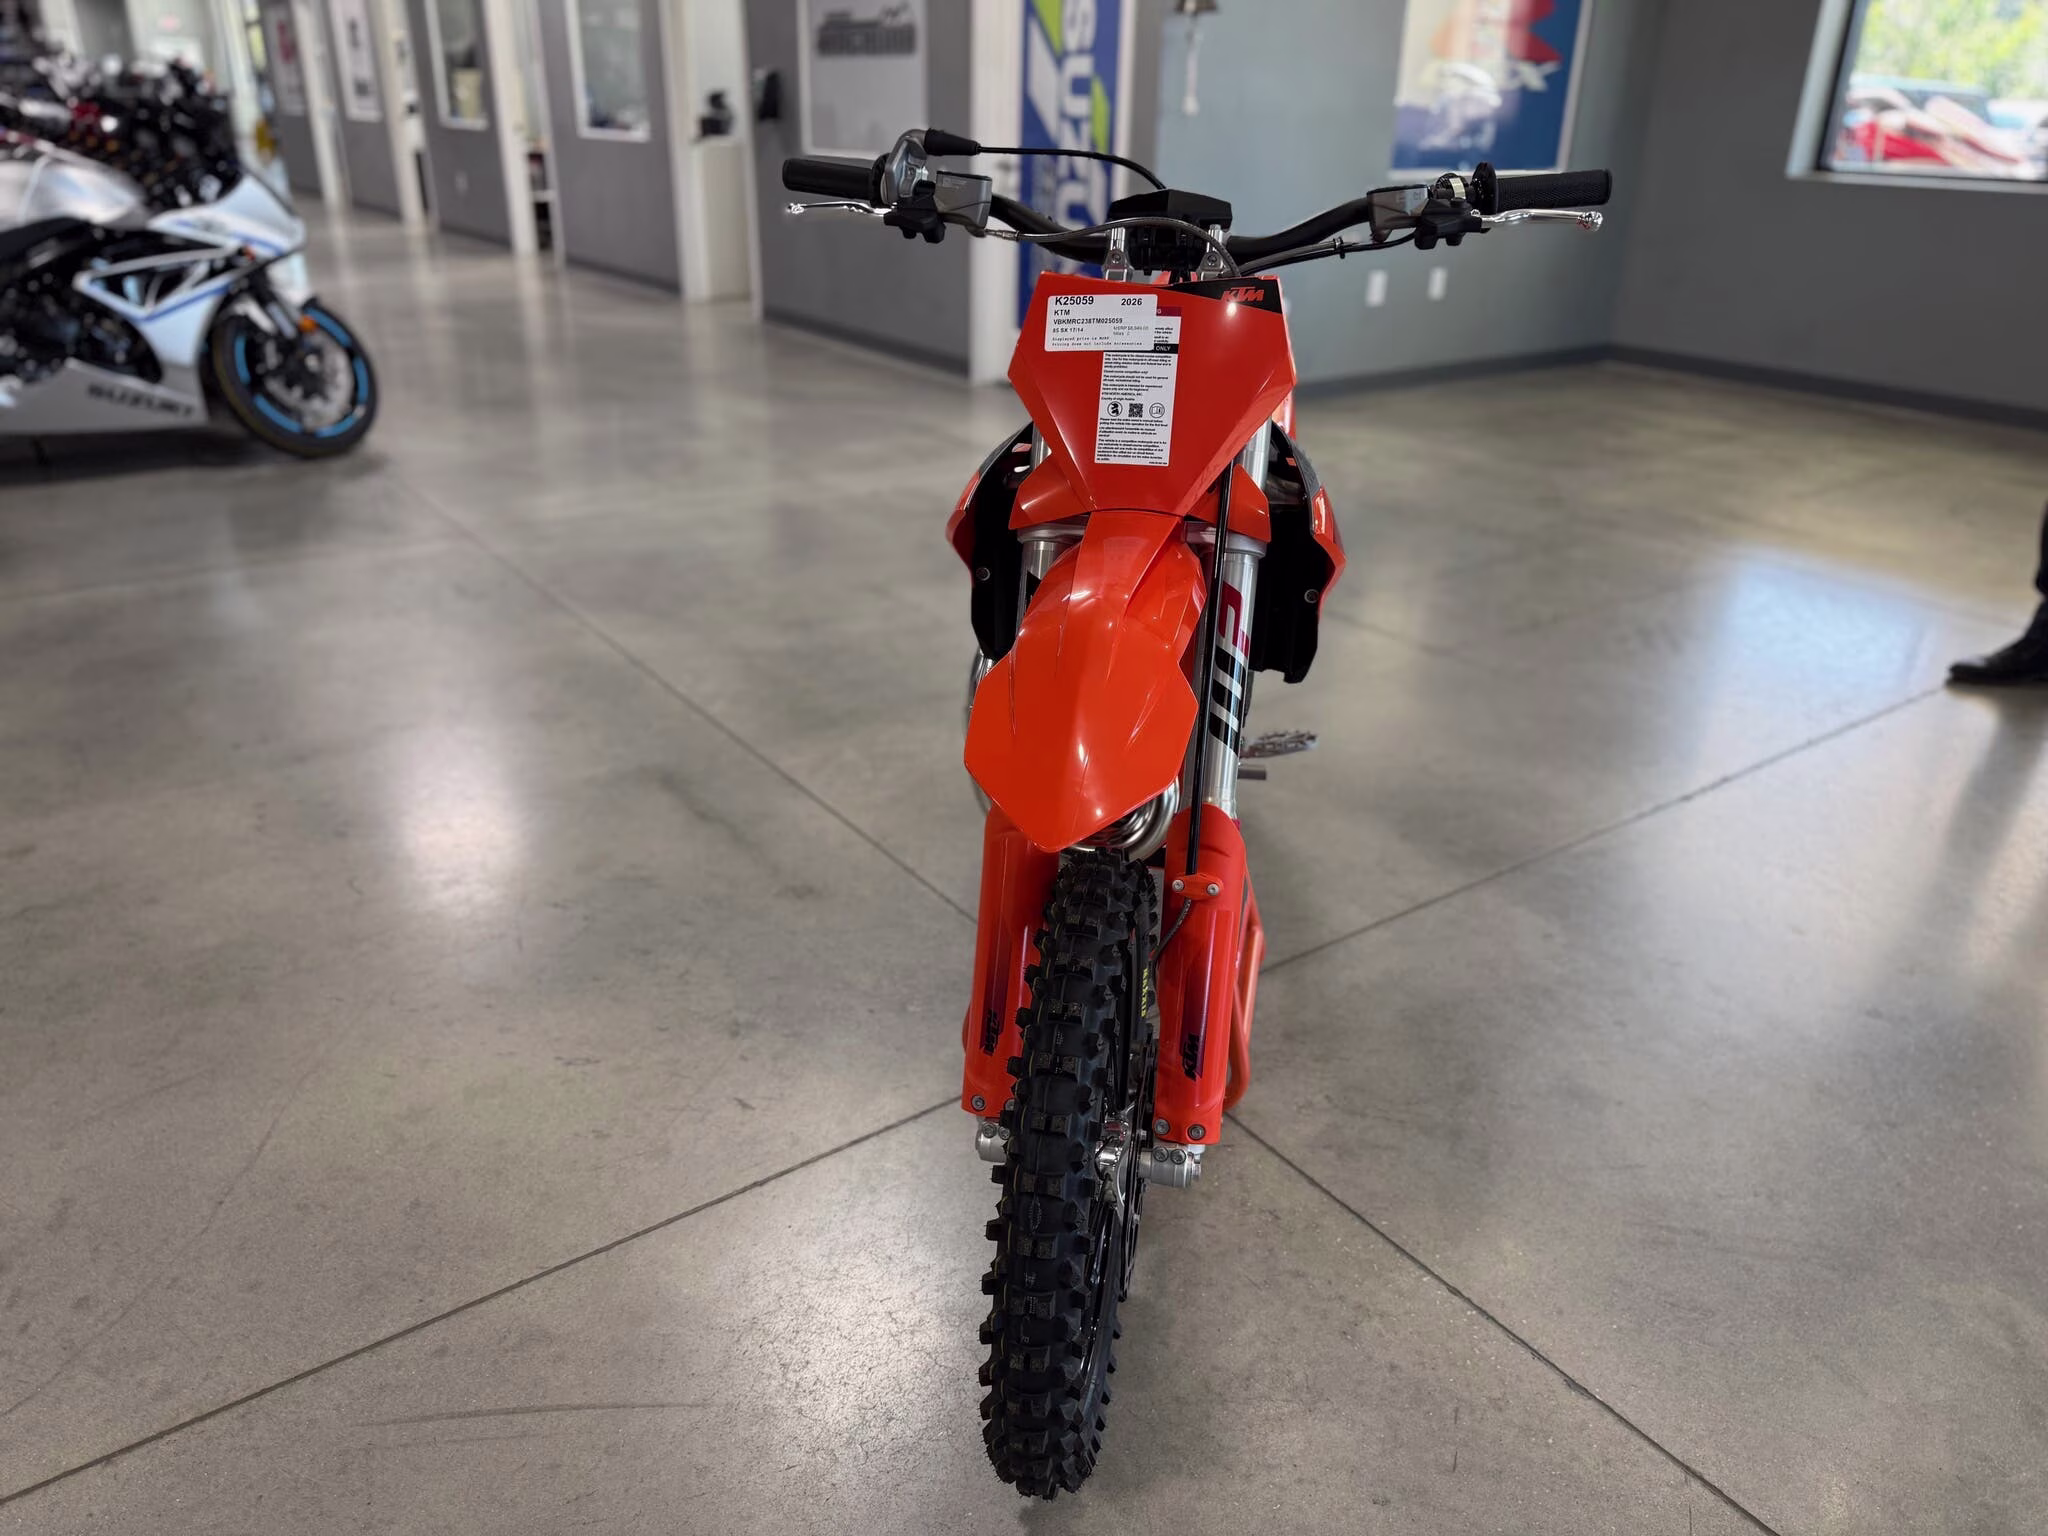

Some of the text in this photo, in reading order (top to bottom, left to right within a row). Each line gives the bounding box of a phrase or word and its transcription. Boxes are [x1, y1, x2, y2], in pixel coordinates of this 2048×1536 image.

[1055, 296, 1094, 306] K25059
[1221, 287, 1264, 302] KTM
[1182, 1033, 1200, 1081] KTM
